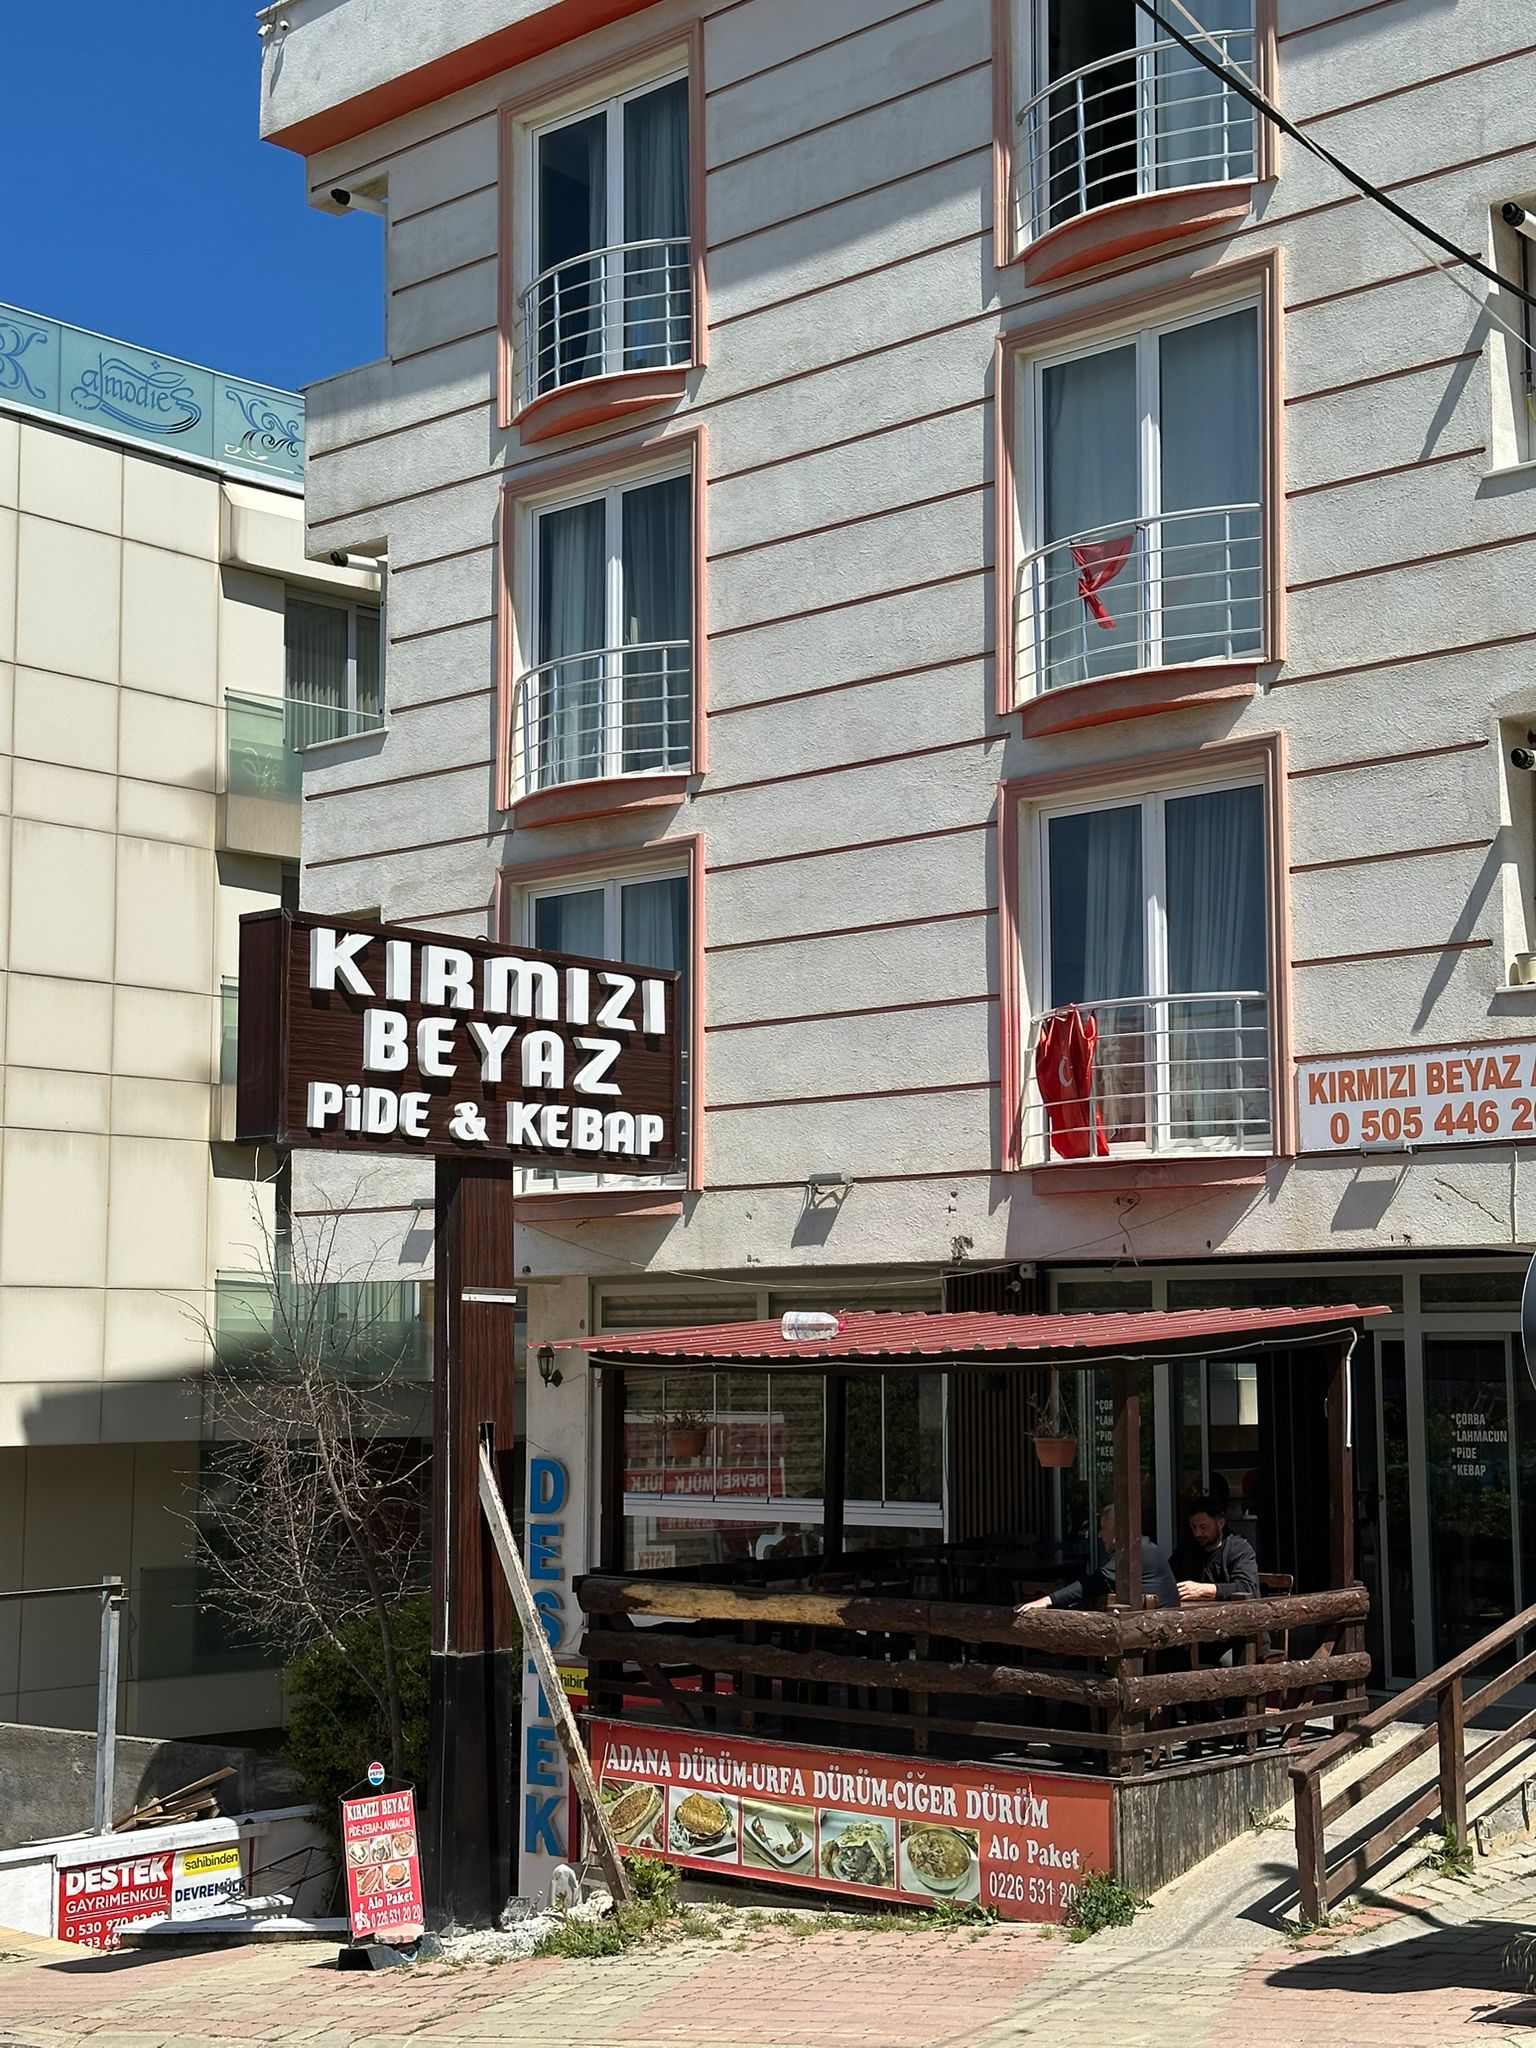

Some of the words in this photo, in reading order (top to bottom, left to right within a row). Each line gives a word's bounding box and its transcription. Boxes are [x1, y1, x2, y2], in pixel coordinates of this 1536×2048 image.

[309, 926, 666, 1035] KIRMIZI
[362, 1008, 623, 1096] BEYAZ
[1308, 1064, 1416, 1105] KIRMIZI
[1426, 1055, 1522, 1095] BEYAZ
[449, 1101, 490, 1142] &
[506, 1101, 664, 1156] KEBAP
[1330, 1112, 1349, 1144] 0
[1361, 1106, 1423, 1142] 505
[1434, 1100, 1499, 1136] 446
[1511, 1098, 1536, 1131] 2
[1455, 1413, 1486, 1428] ÇORBA
[1456, 1430, 1507, 1442] LAHMACUN
[1457, 1464, 1487, 1476] KEBAP
[606, 1743, 672, 1778] ADANA
[678, 1747, 805, 1797] DÜRÜM-URFA
[966, 1783, 1049, 1829] DÜRÜM
[347, 1801, 380, 1821] KIRMIZI
[381, 1796, 409, 1815] BEYAZ
[185, 1852, 239, 1870] sahibinden
[988, 1834, 1019, 1862] Alo
[1026, 1839, 1080, 1870] Paket
[65, 1855, 169, 1897] DESTEK
[989, 1871, 1023, 1901] 0226
[1029, 1877, 1053, 1906] 531
[368, 1896, 383, 1910] Alo
[385, 1890, 414, 1906] Paket
[371, 1914, 375, 1927] 0
[377, 1909, 389, 1927] 226
[389, 1907, 400, 1924] 531
[402, 1905, 411, 1921] 20
[412, 1903, 421, 1921] 20
[66, 1926, 75, 1938] 0
[79, 1921, 102, 1936] 530
[104, 1933, 122, 1946] 66
